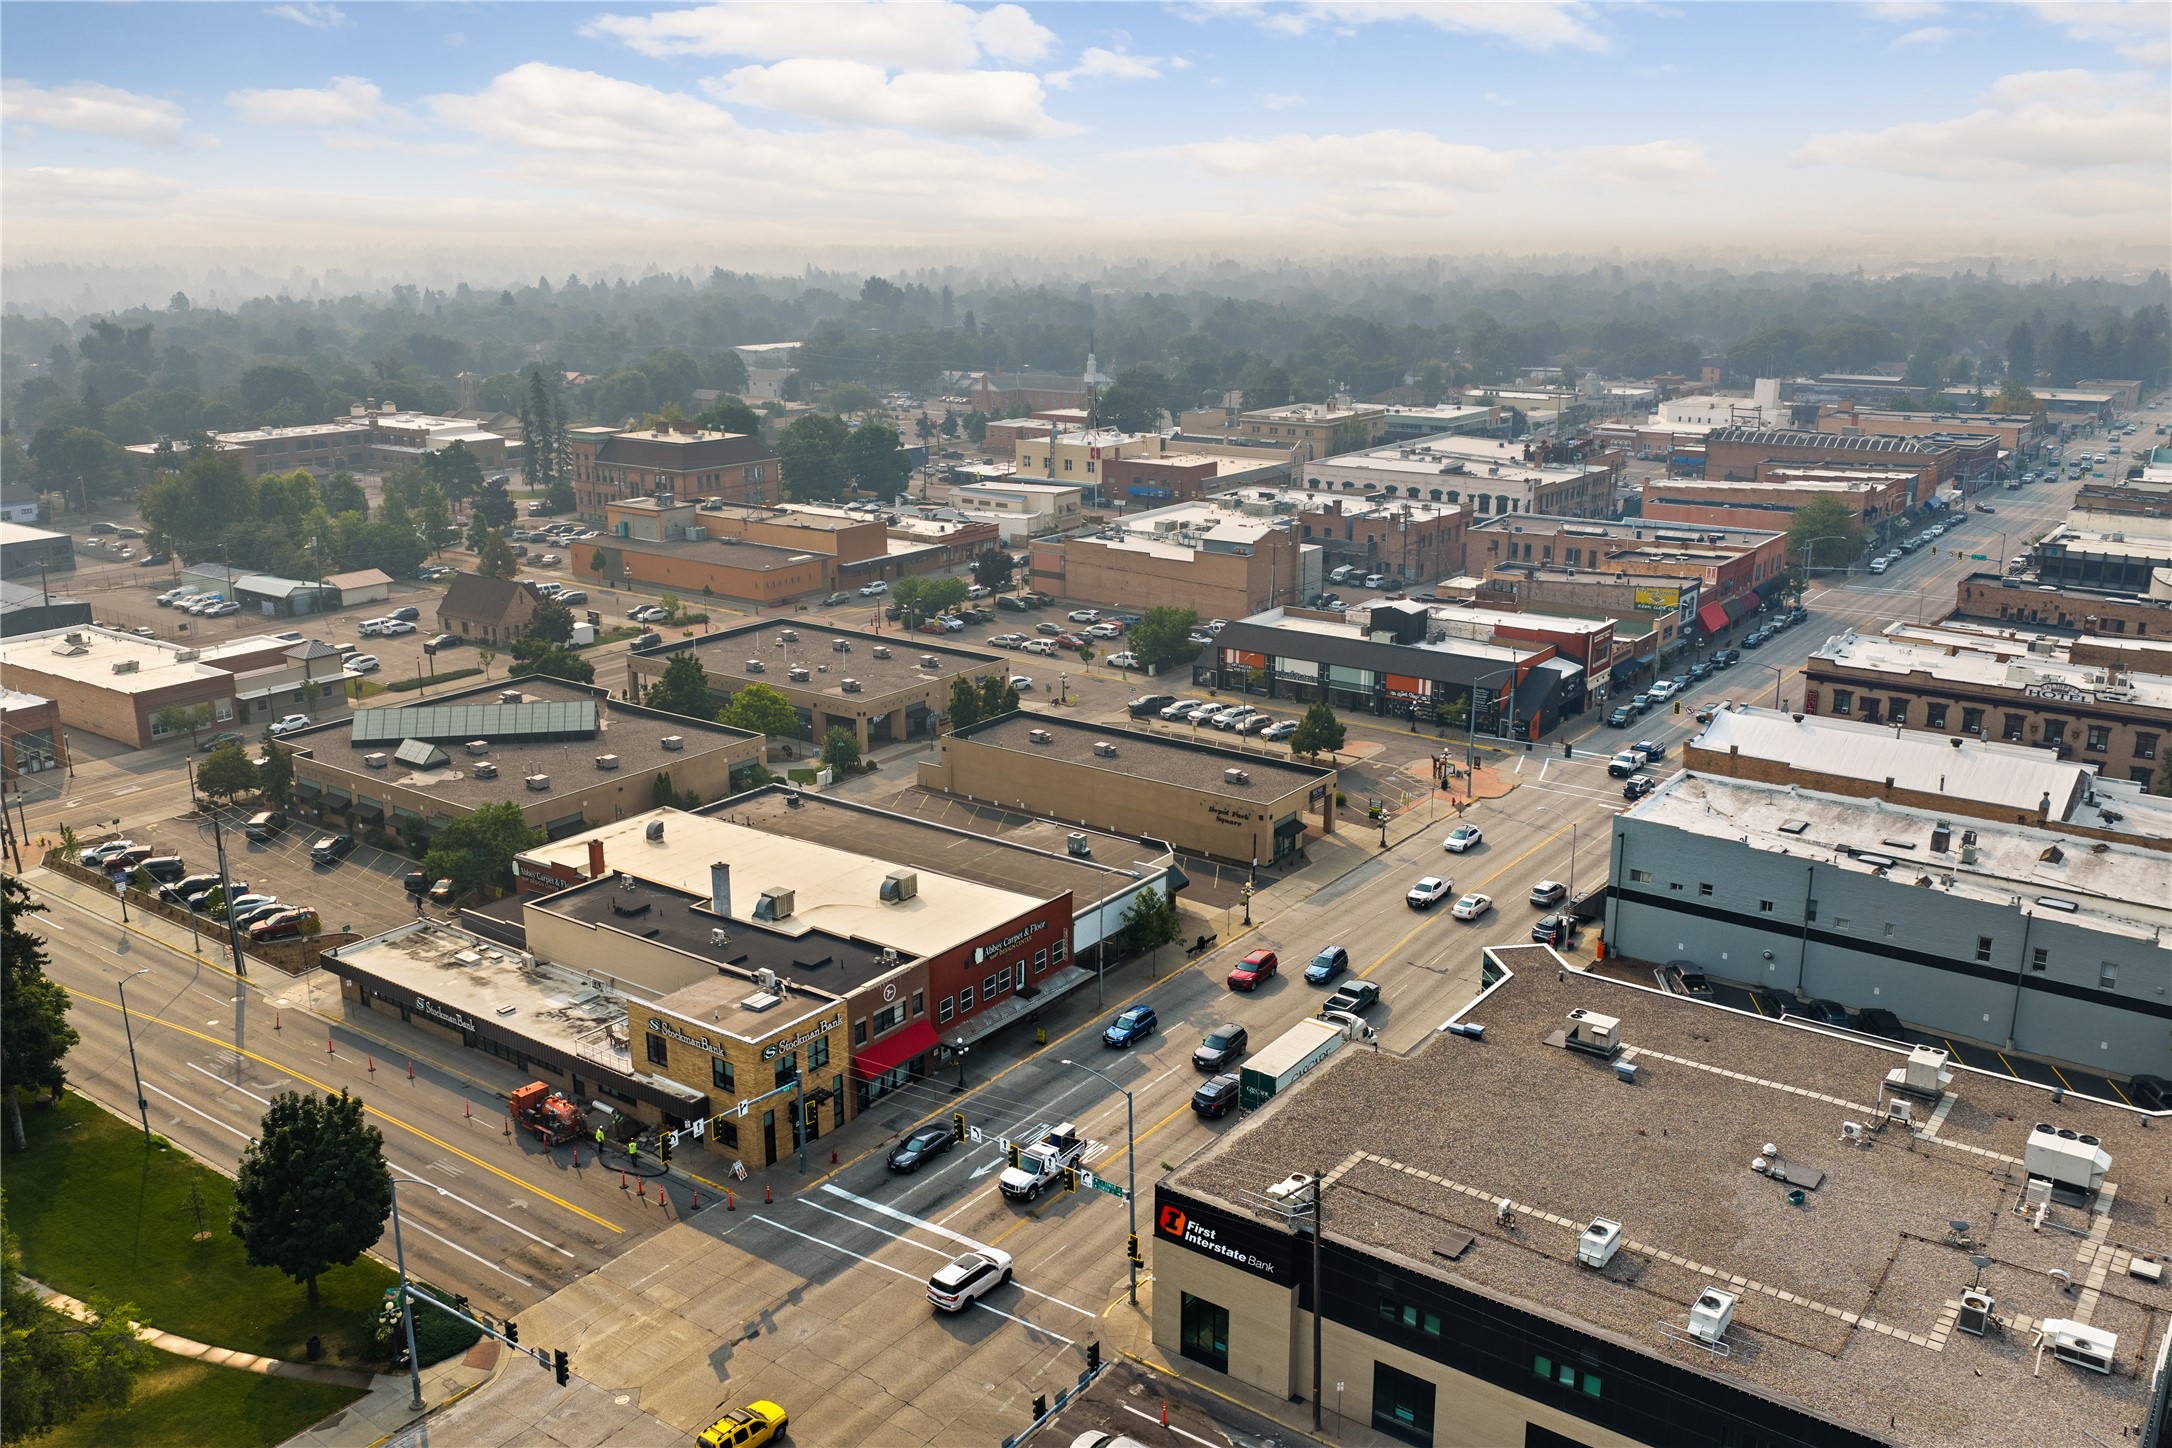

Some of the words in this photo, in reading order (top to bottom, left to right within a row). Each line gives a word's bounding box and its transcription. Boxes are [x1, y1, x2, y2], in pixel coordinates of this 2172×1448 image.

[1807, 692, 1815, 715] HOT
[2029, 689, 2091, 704] HOTEL
[1208, 804, 1229, 816] Depot
[1231, 810, 1250, 821] Park
[1215, 815, 1242, 827] Square
[521, 867, 536, 880] Abbey
[536, 872, 555, 885] Carpet
[555, 878, 560, 886] &
[984, 942, 1003, 956] Abbey
[1003, 931, 1023, 947] Carpet
[1023, 928, 1030, 937] &
[1030, 920, 1046, 934] Floor
[1187, 1220, 1217, 1239] First
[1184, 1231, 1247, 1262] Interstate
[1247, 1255, 1275, 1274] Bank
